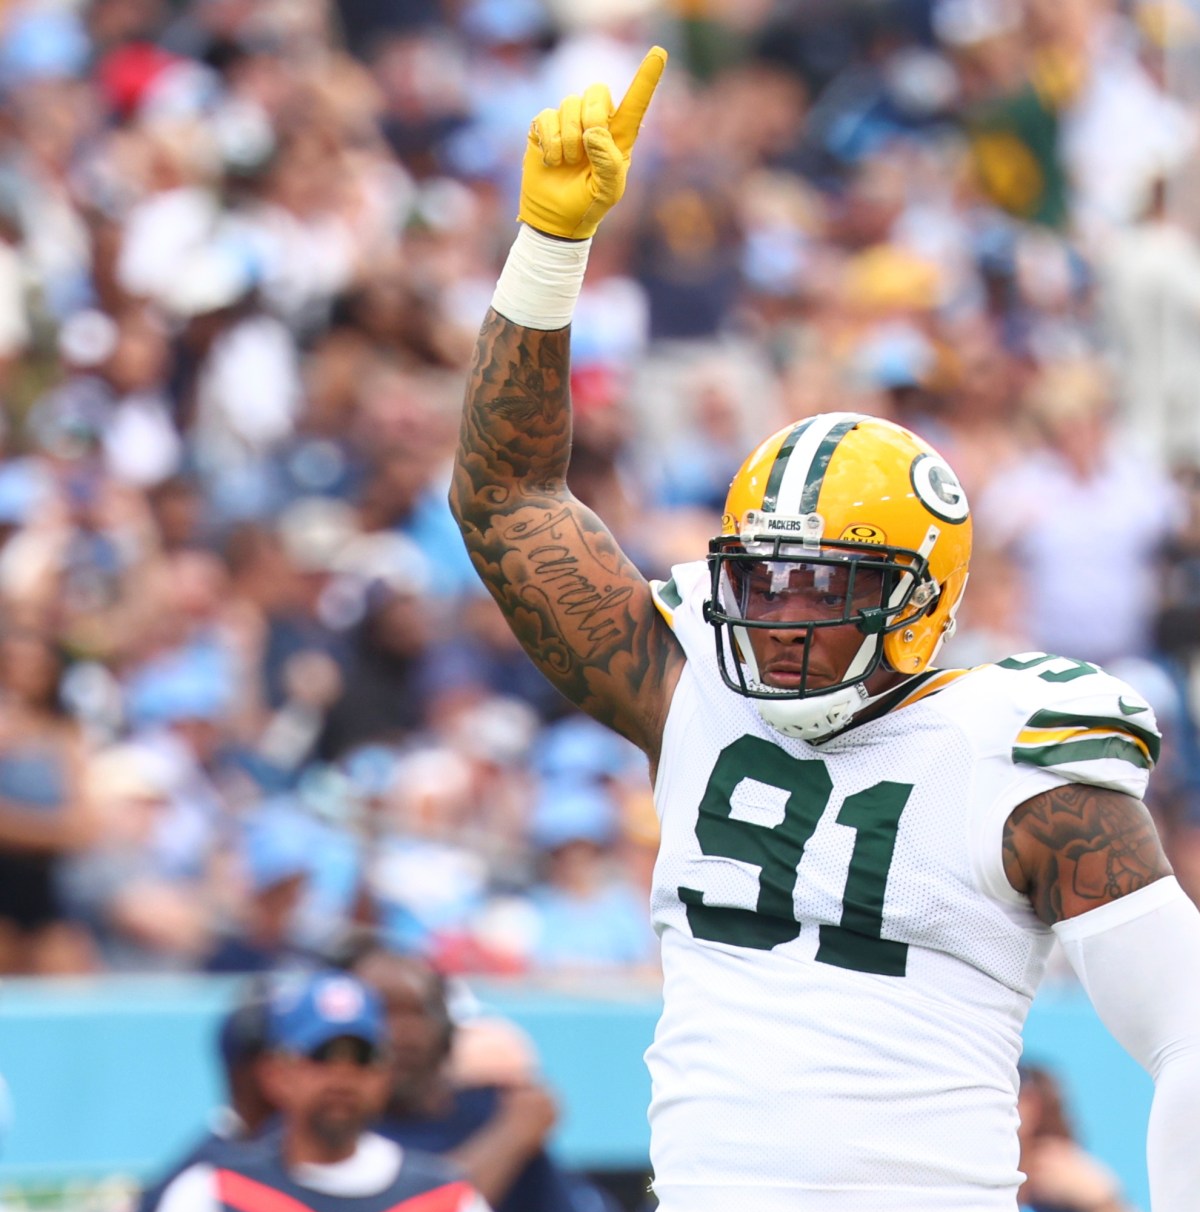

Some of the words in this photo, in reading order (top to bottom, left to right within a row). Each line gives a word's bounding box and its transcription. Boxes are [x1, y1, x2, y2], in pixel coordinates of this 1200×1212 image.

[905, 452, 970, 525] G
[768, 519, 801, 532] PACKERS
[677, 733, 915, 978] 91
